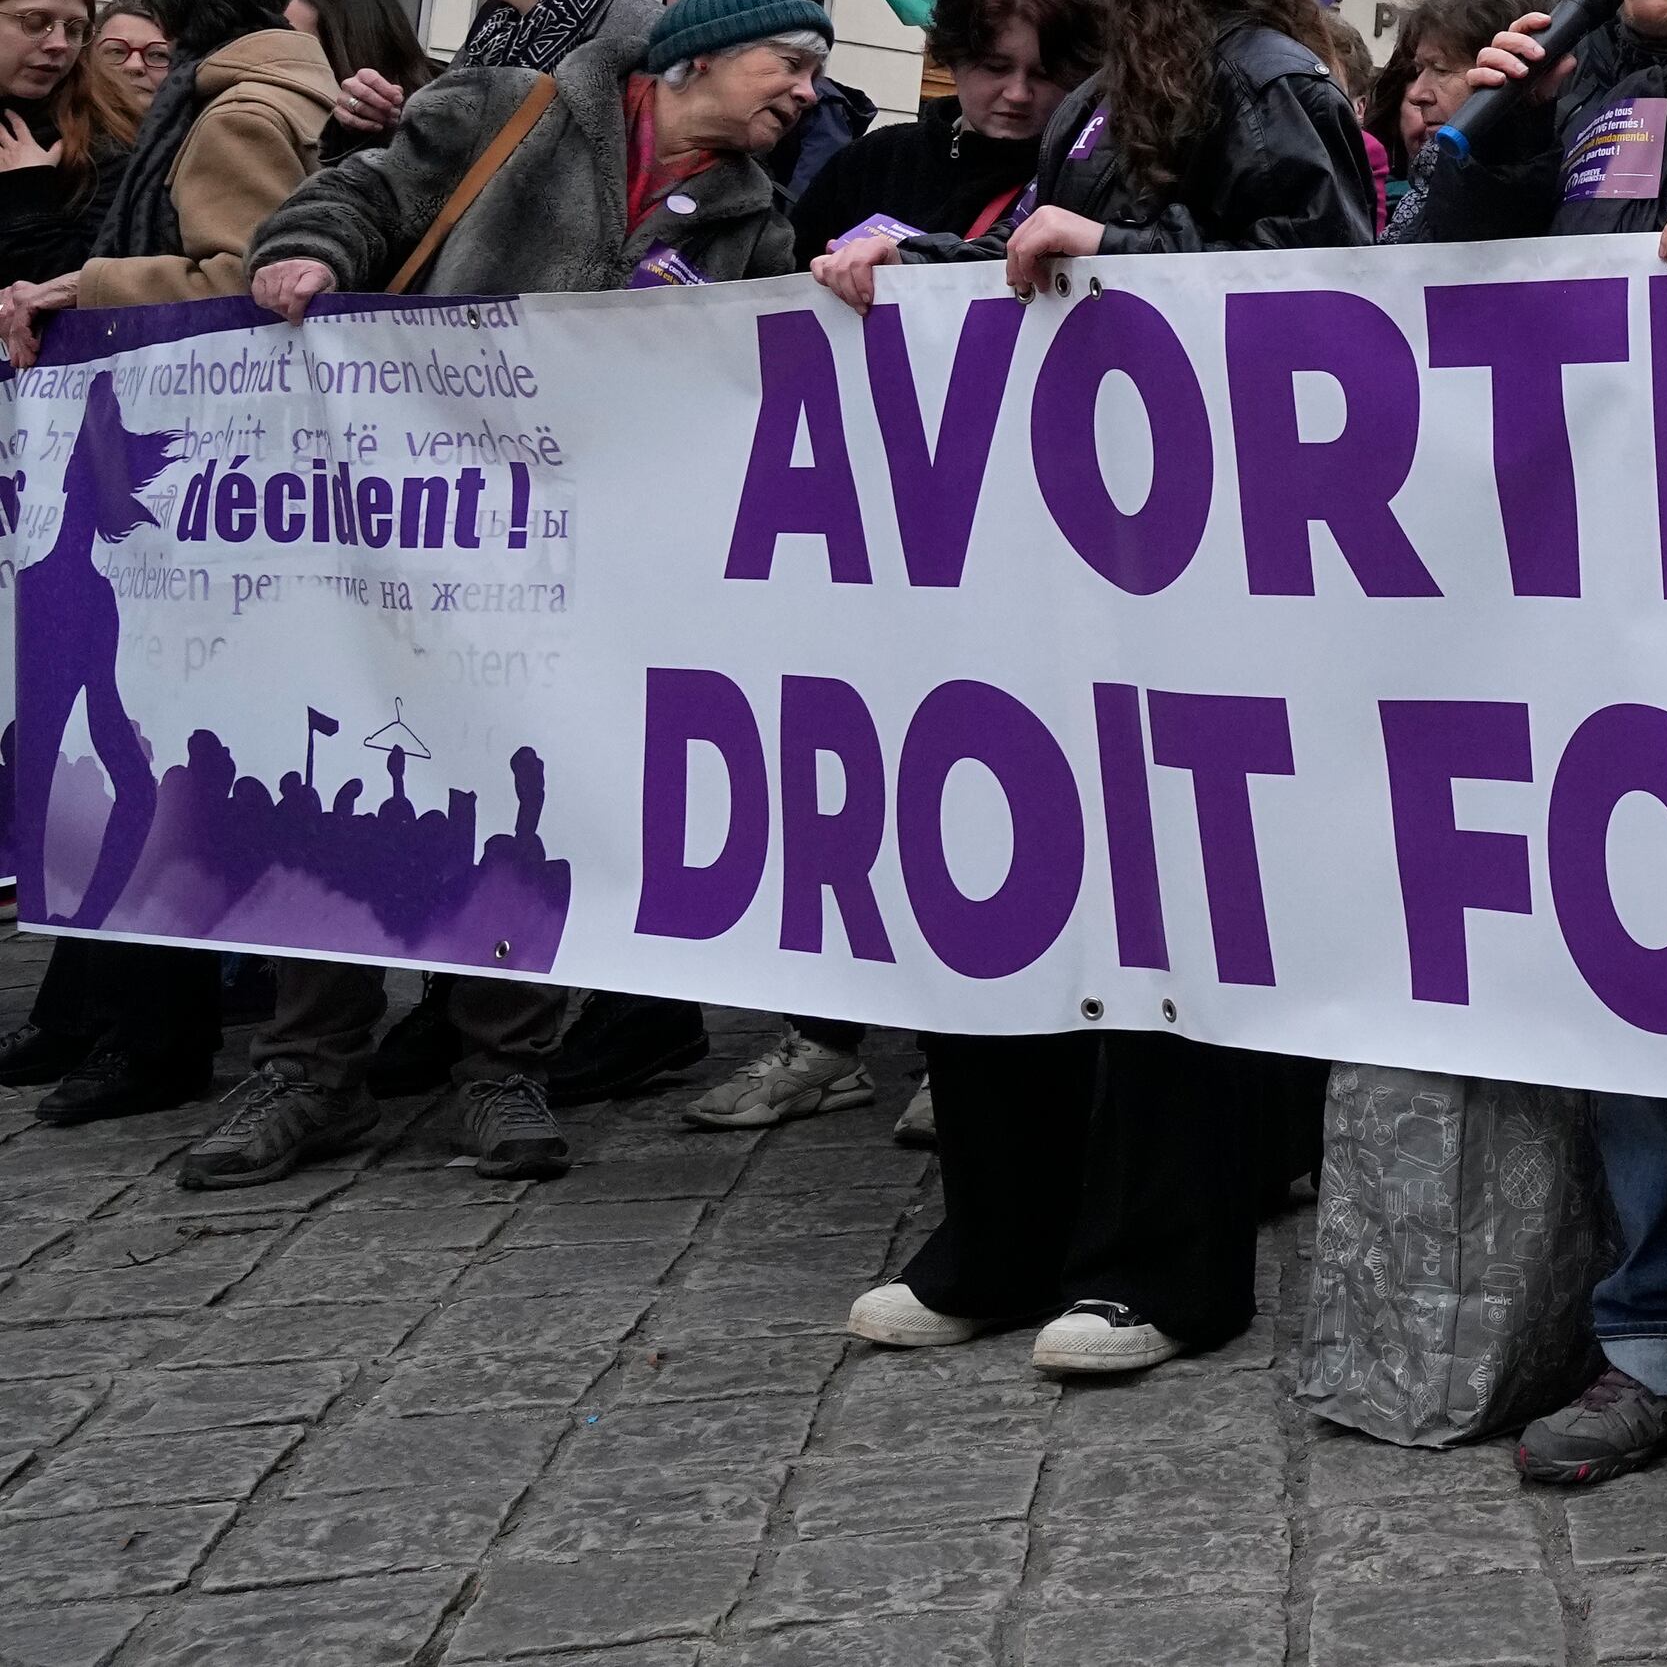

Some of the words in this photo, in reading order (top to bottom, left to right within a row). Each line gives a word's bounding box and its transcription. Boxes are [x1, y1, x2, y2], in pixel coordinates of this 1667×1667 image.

[1615, 107, 1633, 117] tous
[1608, 118, 1639, 131] fermés
[1595, 131, 1649, 146] fondamental
[1585, 146, 1616, 162] partout
[426, 348, 538, 398] decide
[176, 455, 486, 549] décident
[507, 462, 531, 549] !
[379, 580, 414, 612] на
[430, 581, 568, 612] жената
[633, 666, 1295, 988] DROIT
